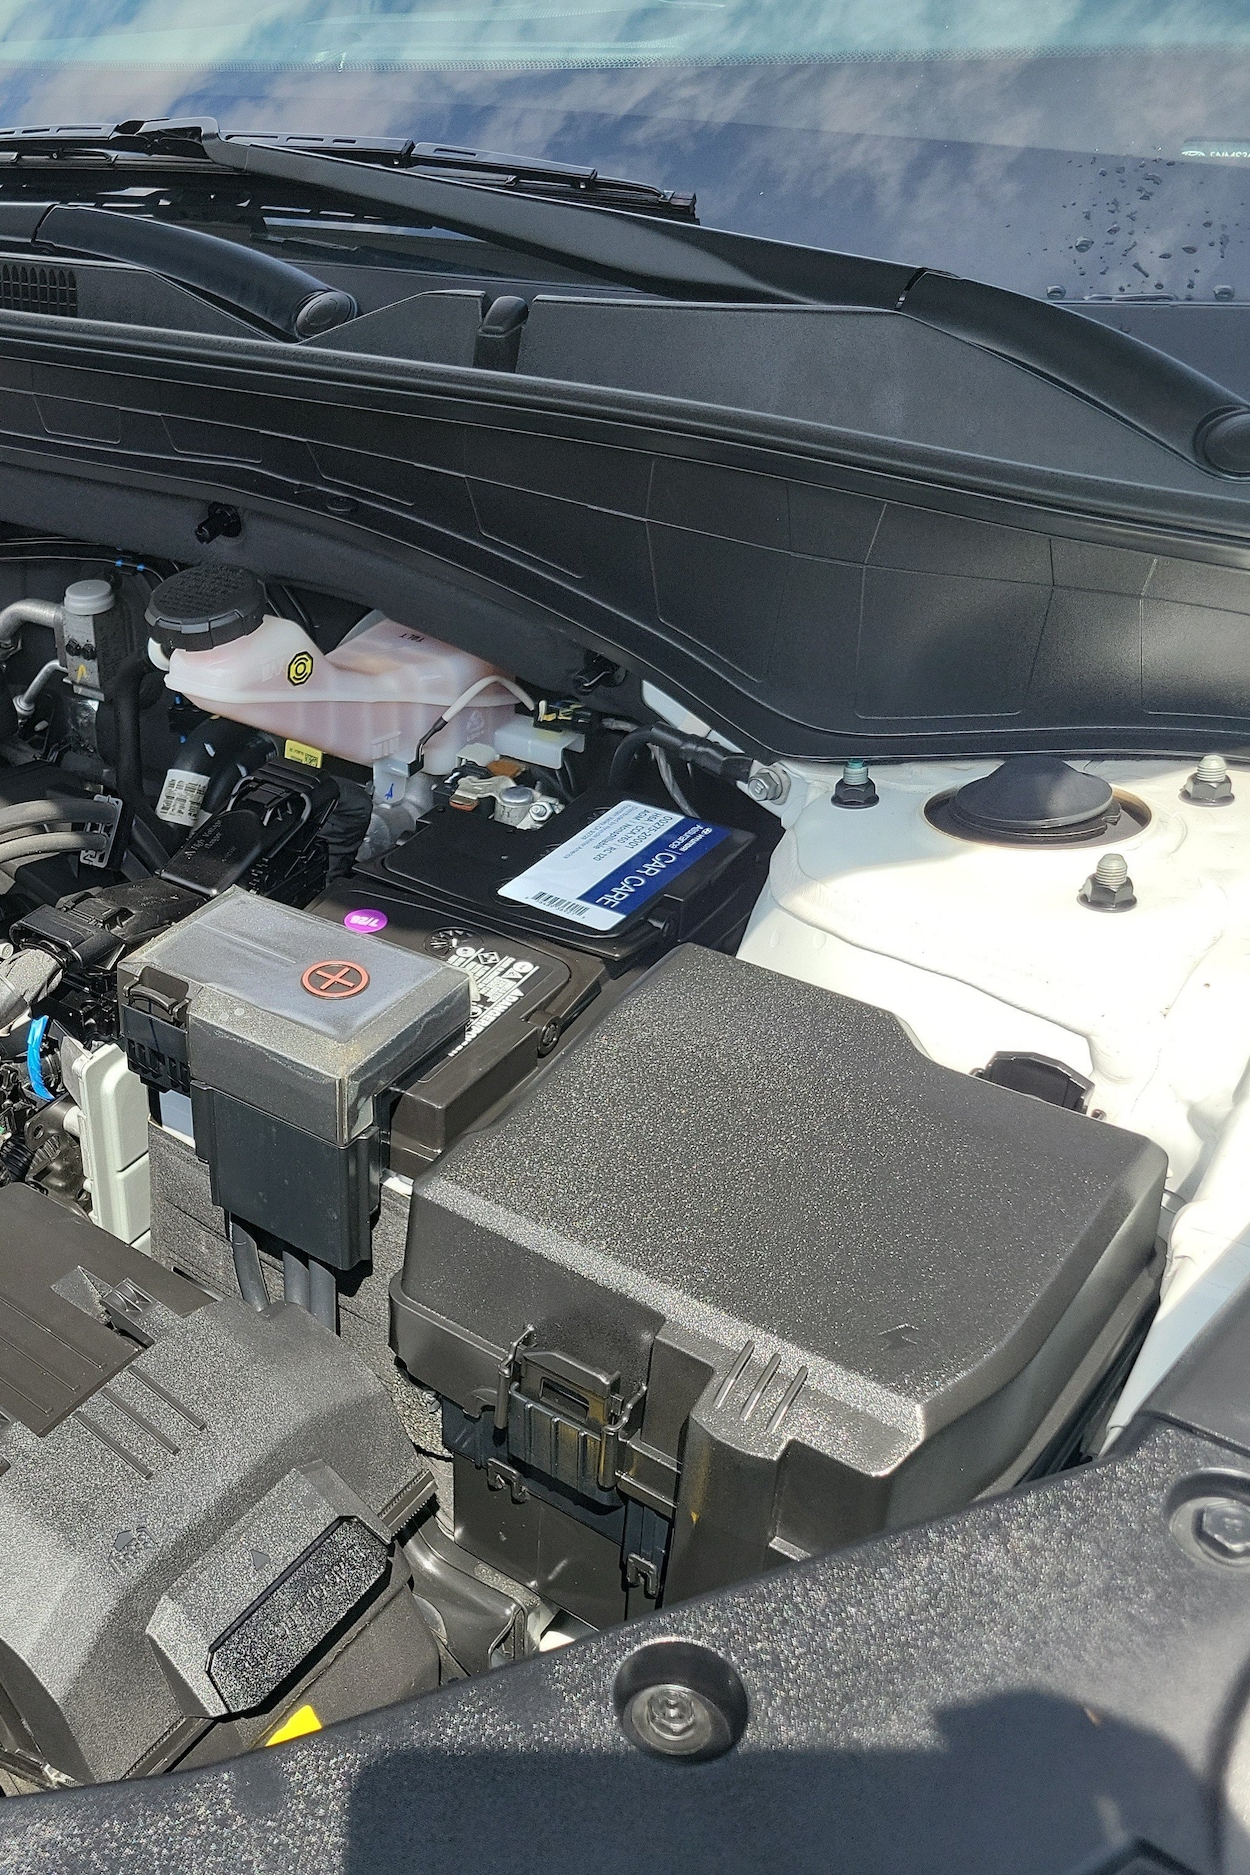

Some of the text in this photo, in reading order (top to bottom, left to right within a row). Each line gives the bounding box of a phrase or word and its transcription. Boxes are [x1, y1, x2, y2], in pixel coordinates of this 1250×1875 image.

[667, 823, 704, 849] Assurance
[595, 850, 677, 908] CAR CARE
